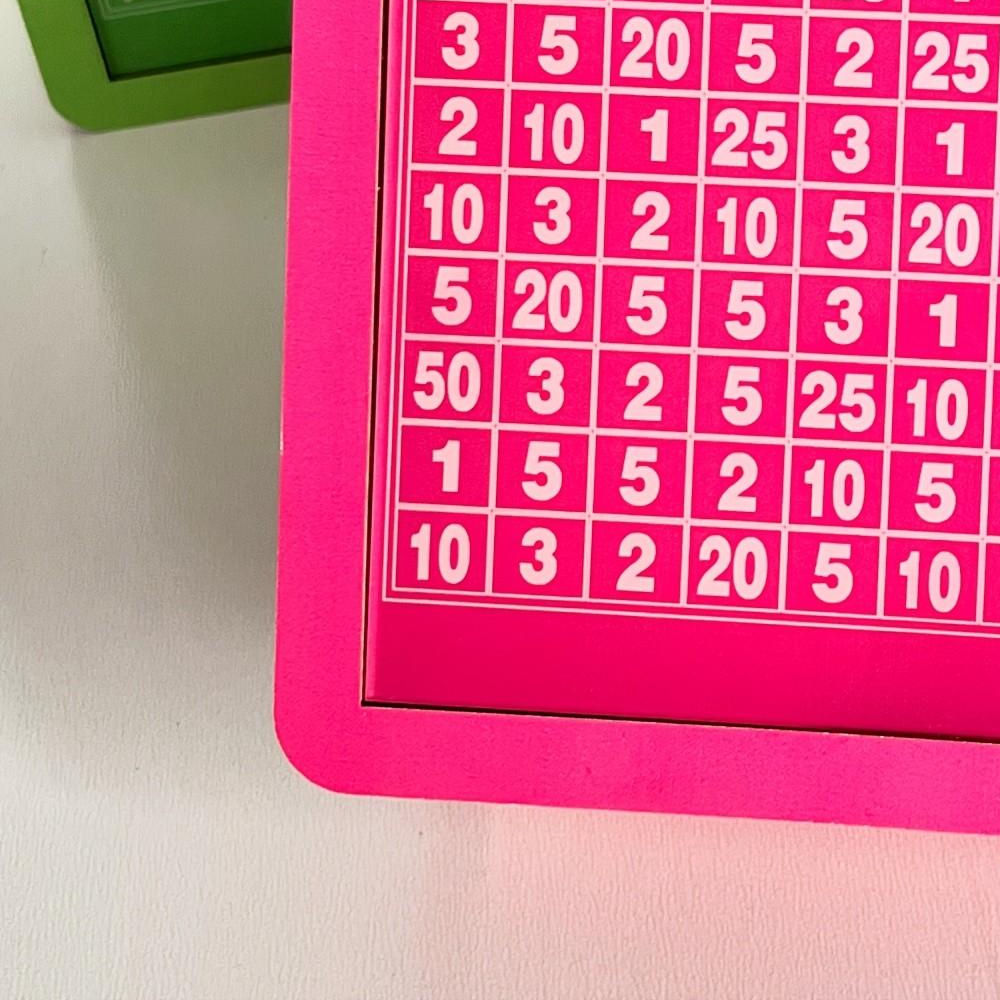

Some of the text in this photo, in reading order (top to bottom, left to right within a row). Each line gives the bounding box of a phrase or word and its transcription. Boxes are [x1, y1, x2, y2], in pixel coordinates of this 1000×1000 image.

[441, 11, 480, 70] 3
[537, 14, 579, 75] 5
[619, 16, 691, 81] 20
[735, 23, 777, 84] 5
[833, 27, 874, 89] 2
[911, 31, 990, 94] 25
[438, 96, 478, 156] 2
[524, 103, 585, 165] 10
[640, 109, 669, 162] 1
[711, 107, 788, 170] 25
[831, 115, 870, 174] 3
[935, 122, 965, 176] 1
[423, 183, 484, 244] 10
[533, 186, 571, 245] 3
[630, 190, 671, 251] 2
[716, 197, 778, 259] 10
[826, 199, 868, 260] 5
[908, 201, 980, 267] 20
[410, 523, 470, 585] 10
[519, 527, 557, 585] 3
[616, 532, 657, 593] 2
[696, 535, 768, 600] 20
[811, 542, 854, 604] 5
[899, 551, 961, 613] 10
